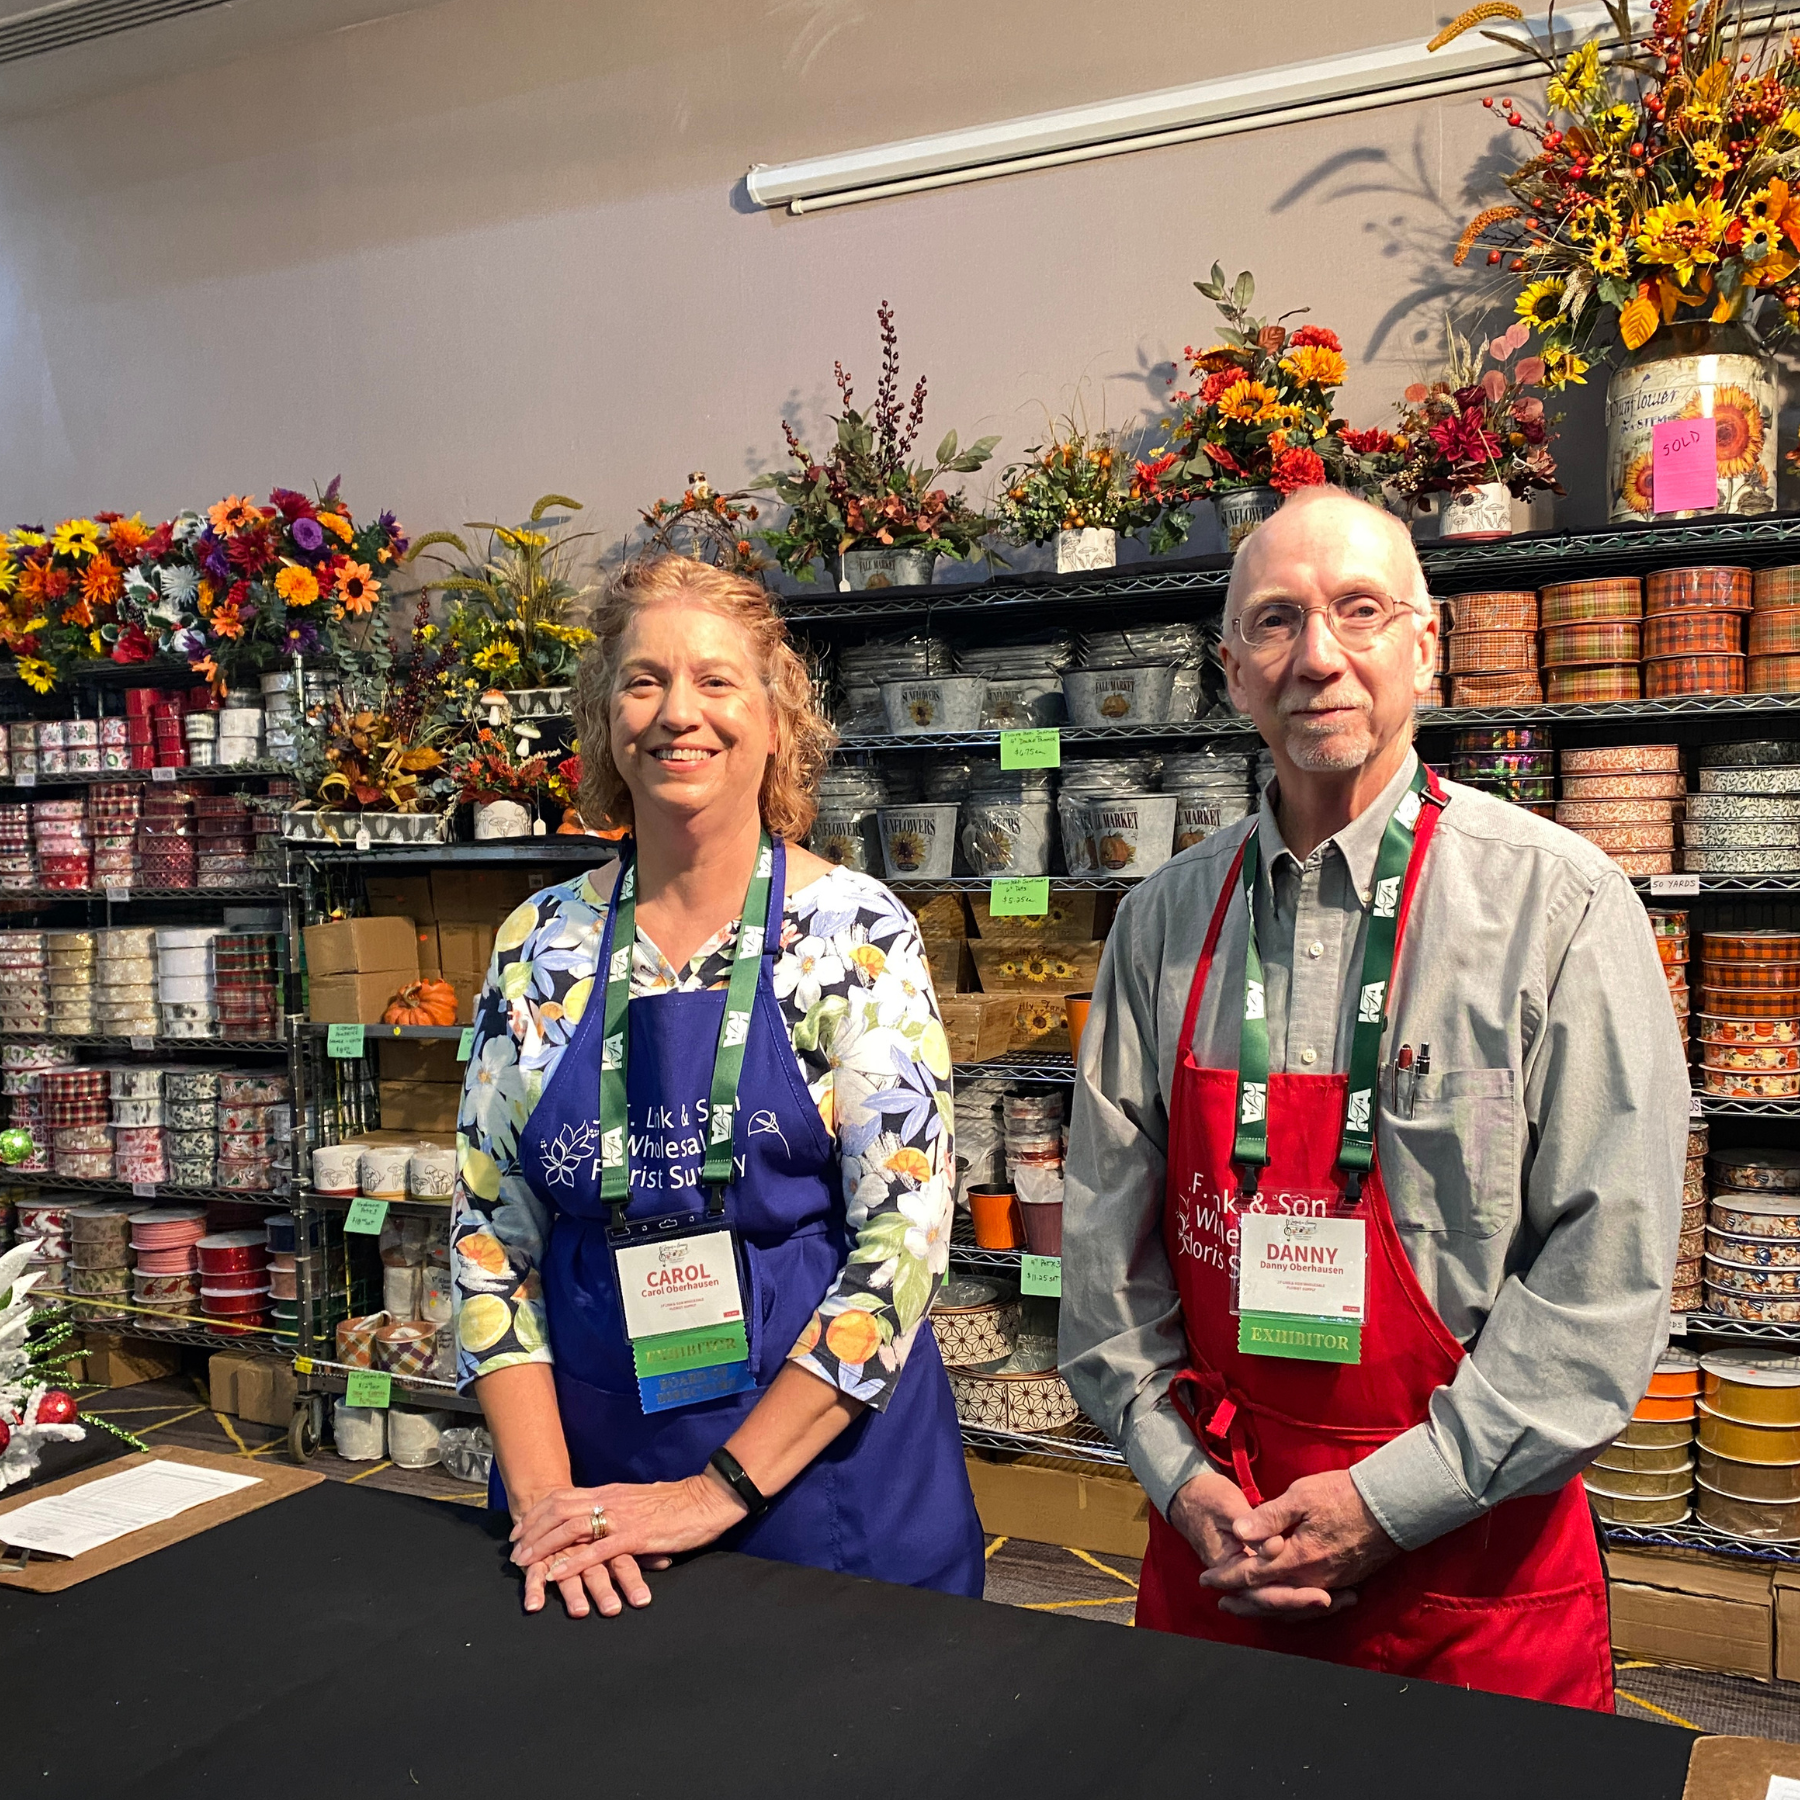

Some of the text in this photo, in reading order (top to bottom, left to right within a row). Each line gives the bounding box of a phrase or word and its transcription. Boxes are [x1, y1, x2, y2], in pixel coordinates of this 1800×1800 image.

[1663, 431, 1700, 456] SOLD
[1103, 812, 1138, 829] MARKET
[1184, 809, 1221, 826] MARKET
[1668, 880, 1696, 888] YARDS
[681, 1104, 689, 1126] &
[627, 1129, 707, 1159] Wholesal
[1250, 1192, 1268, 1215] &
[1278, 1193, 1327, 1217] Son
[1267, 1244, 1338, 1264] DANNY
[647, 1264, 710, 1287] CAROL
[1260, 1261, 1344, 1274] Danny Oberhausen
[641, 1279, 719, 1297] Carol Oberhausen
[1251, 1327, 1349, 1350] EXHIBITOR
